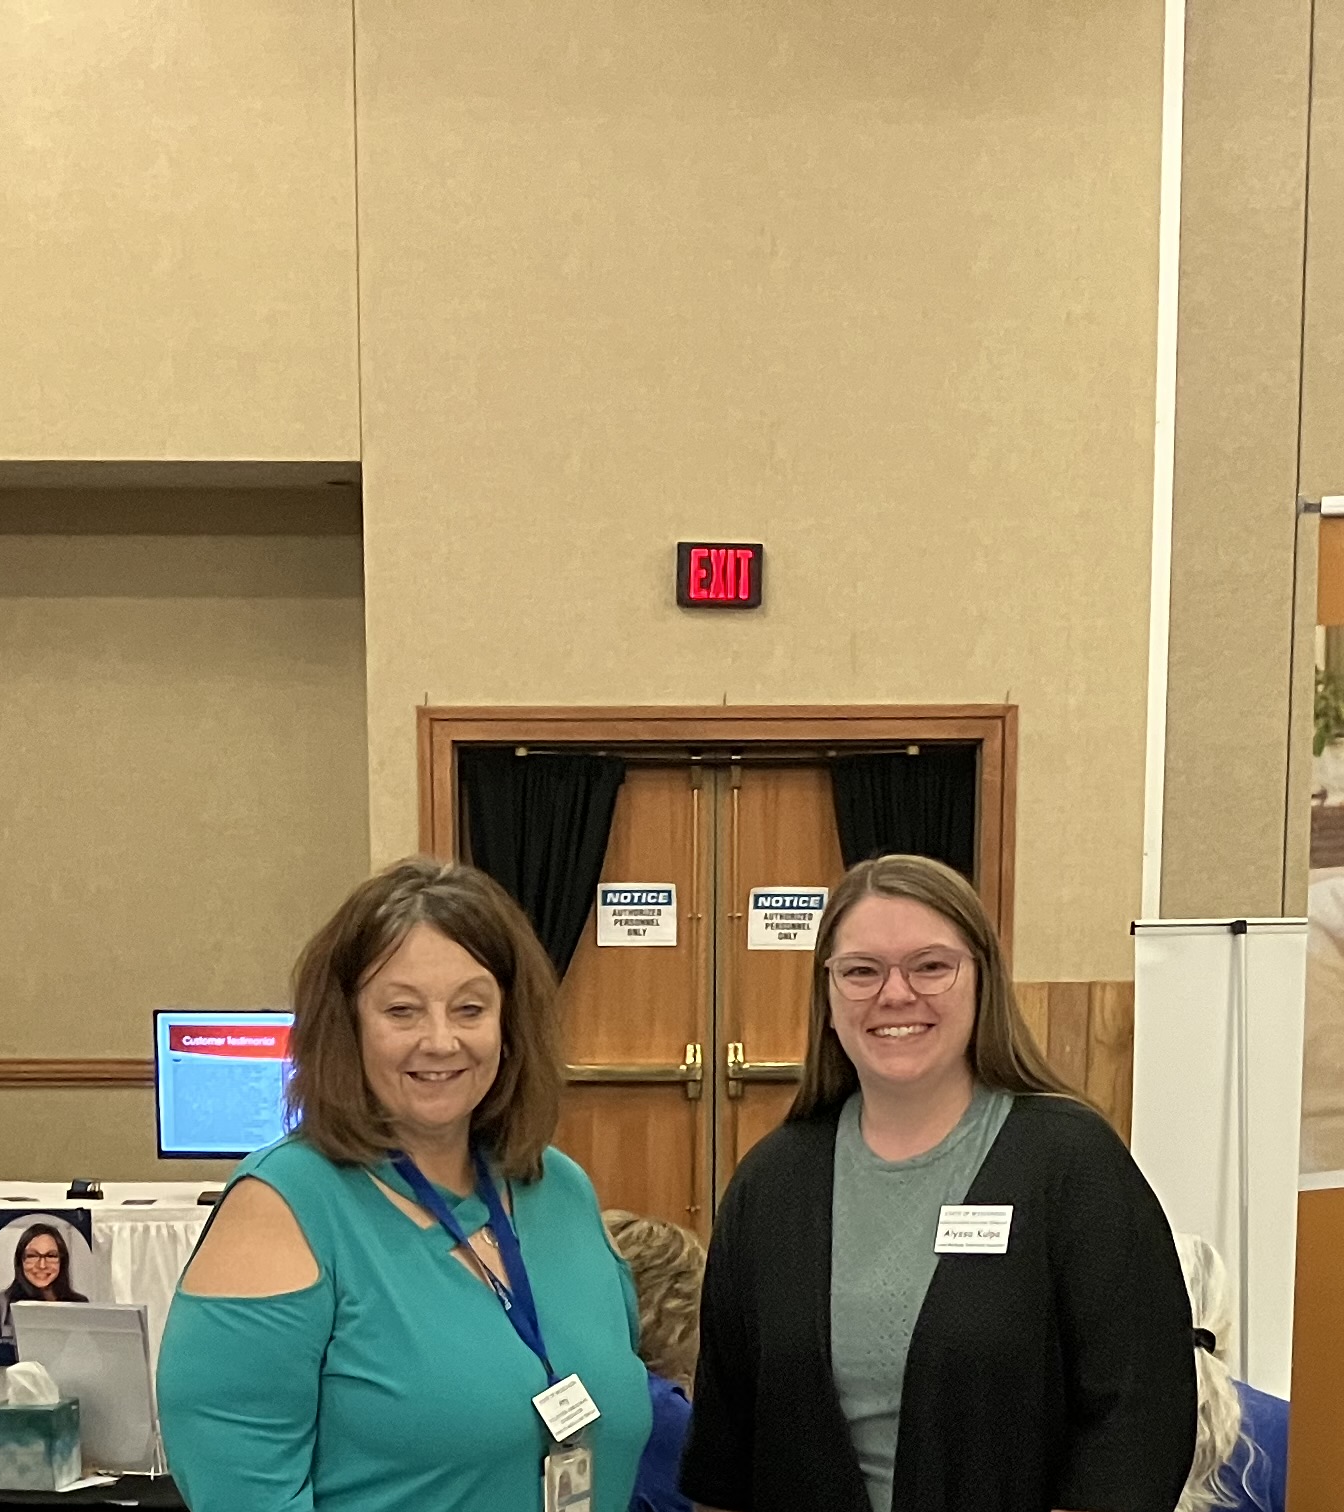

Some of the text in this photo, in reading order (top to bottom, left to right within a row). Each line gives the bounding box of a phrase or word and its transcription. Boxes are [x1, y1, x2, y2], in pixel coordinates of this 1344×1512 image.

[689, 548, 753, 600] EXIT
[606, 892, 669, 903] NOTICE
[757, 896, 820, 907] NOTICE
[614, 919, 660, 927] PERSONNEL
[765, 922, 811, 930] PERSONNEL
[627, 928, 648, 937] ONLY
[778, 932, 798, 940] ONLY
